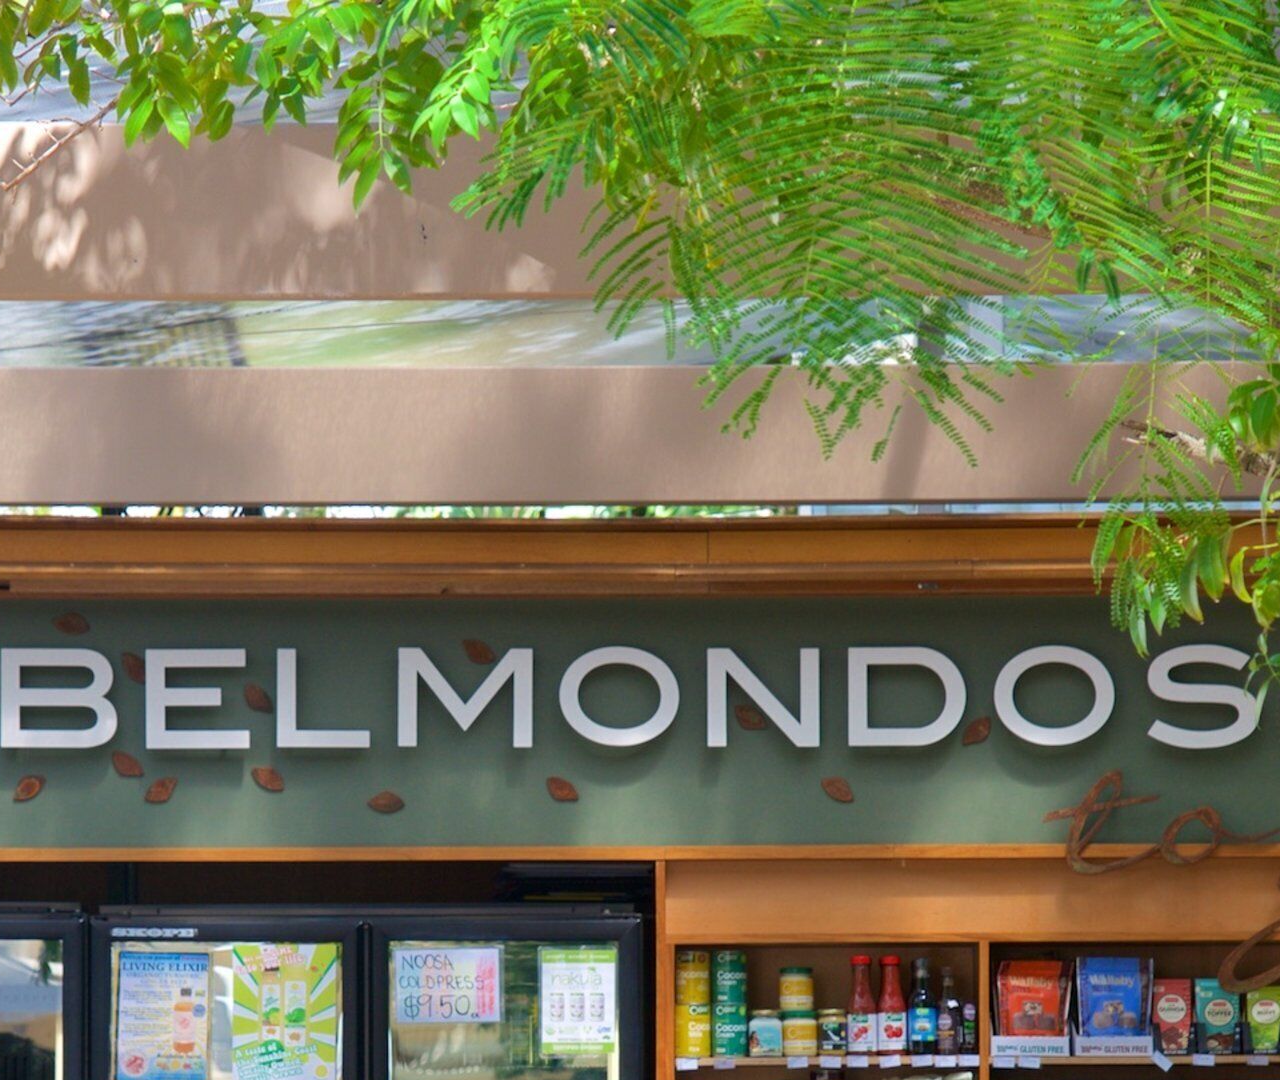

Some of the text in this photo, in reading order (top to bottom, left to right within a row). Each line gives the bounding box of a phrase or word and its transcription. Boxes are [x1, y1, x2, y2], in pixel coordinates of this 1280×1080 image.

[0, 646, 1261, 750] BELMONDOS
[122, 961, 208, 973] LIVING ELIXIR
[402, 954, 454, 970] NOOSA
[403, 992, 471, 1020] $9.50
[1019, 1044, 1046, 1054] GLUTEN
[1048, 1044, 1065, 1054] FREE
[1104, 1044, 1130, 1054] GLUTEN
[1131, 1044, 1148, 1054] FREE
